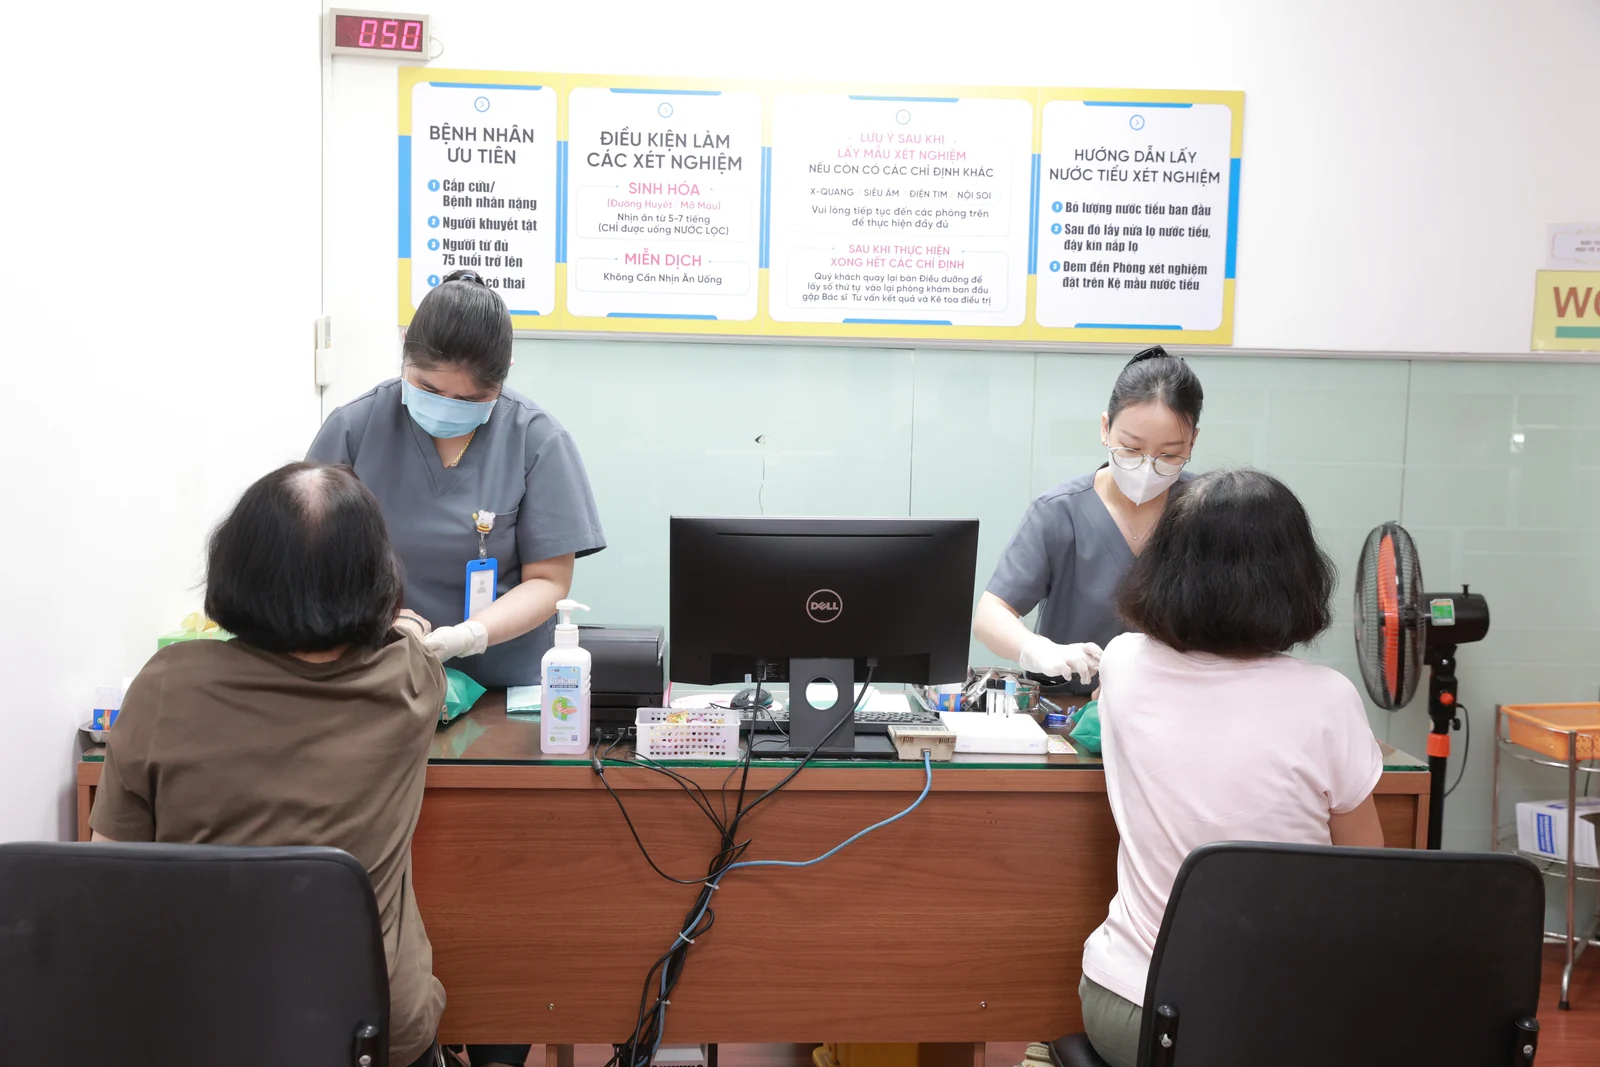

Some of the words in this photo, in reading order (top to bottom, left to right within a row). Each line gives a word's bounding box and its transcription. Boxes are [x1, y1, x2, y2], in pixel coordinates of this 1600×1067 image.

[359, 20, 420, 49] 050
[430, 122, 476, 144] BỆNH
[484, 125, 534, 143] NHÂN
[600, 126, 641, 146] ĐIỀU
[648, 130, 686, 151] KIỆN
[694, 130, 730, 148] LÀM
[860, 132, 882, 143] LƯU
[886, 131, 894, 143] Ý
[898, 134, 922, 144] SAU
[926, 134, 944, 144] KHI
[448, 147, 471, 162] ƯU
[478, 146, 515, 164] TIÊN
[587, 149, 627, 168] CÁC
[634, 150, 665, 168] XÉT
[671, 152, 742, 174] NGHIỆM
[838, 145, 860, 158] LẤY
[864, 145, 890, 159] MẪU
[894, 148, 915, 160] XÉT
[919, 149, 966, 163] NGHIỆM
[1075, 146, 1129, 162] HƯỚNG
[1134, 145, 1165, 163] DẪN
[1170, 147, 1197, 164] LẤY
[809, 161, 830, 174] NẾU
[834, 162, 859, 174] CÒN
[862, 164, 879, 175] CÓ
[883, 164, 907, 176] CÁC
[911, 164, 930, 176] CHỈ
[933, 167, 960, 179] ĐỊNH
[963, 166, 994, 178] KHÁC
[1050, 165, 1093, 181] NƯỚC
[1098, 165, 1128, 182] TIỂU
[1133, 167, 1158, 183] XÉT
[1163, 169, 1220, 187] NGHIỆM
[443, 178, 464, 193] Cấp
[469, 180, 495, 193] cứu/
[629, 182, 662, 194] SINH
[668, 180, 700, 196] HÓA
[810, 188, 854, 196] X-QUANG
[864, 187, 882, 197] SIÊU
[885, 188, 899, 197] ÂM
[909, 189, 930, 199] ĐIỆN
[933, 190, 948, 198] TIM
[957, 189, 973, 201] NỘI
[976, 191, 991, 199] SOI
[443, 195, 472, 209] Bệnh
[476, 196, 504, 208] nhân
[508, 197, 537, 211] nặng
[645, 200, 672, 210] Huyết
[1066, 201, 1078, 213] Bỏ
[1082, 202, 1112, 216] lượng
[1116, 203, 1142, 214] nước
[1168, 204, 1188, 216] ban
[1191, 203, 1211, 216] đầu
[617, 213, 638, 223] Nhịn
[641, 214, 653, 222] ăn
[656, 214, 666, 222] từ
[668, 214, 684, 223] 5-7
[686, 214, 710, 225] tiếng
[812, 205, 826, 214] Vui
[830, 206, 850, 216] lòng
[854, 206, 872, 217] tiếp
[876, 207, 891, 217] tục
[894, 206, 912, 216] đến
[915, 208, 930, 216] các
[935, 209, 966, 219] phòng
[969, 209, 989, 217] trên
[443, 217, 475, 230] Người
[480, 217, 518, 231] khuyết
[522, 219, 537, 233] tật
[598, 222, 618, 232] (CHỈ
[621, 224, 644, 235] được
[648, 224, 671, 235] uống
[674, 224, 702, 234] NƯỚC
[706, 226, 729, 237] LỌC)
[867, 219, 888, 229] thực
[892, 219, 912, 230] hiện
[936, 220, 948, 228] đủ
[1064, 224, 1084, 235] Sau
[1087, 224, 1100, 236] đó
[1104, 223, 1119, 237] lấy
[1123, 225, 1142, 236] nửa
[1146, 225, 1155, 239] lọ
[1158, 226, 1184, 237] nước
[443, 238, 475, 251] Người
[480, 239, 492, 251] từ
[494, 239, 508, 252] đủ
[849, 244, 870, 254] SAU
[873, 245, 890, 254] KHI
[893, 245, 922, 257] THỰC
[926, 245, 950, 258] HIỆN
[1064, 240, 1082, 252] đậy
[1086, 240, 1102, 251] kín
[1128, 241, 1138, 254] lọ
[443, 254, 455, 265] 75
[459, 252, 481, 266] tuổi
[485, 254, 501, 267] trở
[505, 256, 522, 267] lên
[625, 248, 660, 266] MIỄN
[665, 254, 702, 270] DỊCH
[830, 258, 863, 267] XONG
[866, 255, 886, 267] HẾT
[889, 256, 914, 268] CÁC
[916, 257, 934, 269] CHỈ
[938, 260, 964, 271] ĐỊNH
[1063, 261, 1086, 272] Đem
[1090, 260, 1109, 272] đến
[1113, 262, 1146, 274] Phòng
[1149, 263, 1165, 274] xét
[1168, 264, 1207, 277] nghiệm
[486, 277, 499, 288] có
[503, 277, 525, 289] thai
[604, 272, 634, 283] Không
[659, 274, 679, 284] Nhịn
[682, 274, 695, 283] Ăn
[698, 274, 722, 285] Uống
[814, 272, 832, 282] Quý
[834, 273, 860, 282] khách
[863, 275, 885, 283] quay
[887, 274, 897, 284] lại
[900, 274, 916, 282] bàn
[942, 275, 968, 285] dưỡng
[1062, 277, 1079, 290] đặt
[1083, 277, 1104, 288] trên
[1108, 278, 1120, 291] Kệ
[1150, 279, 1176, 290] nước
[1553, 286, 1600, 318] W
[810, 602, 838, 610] DELL
